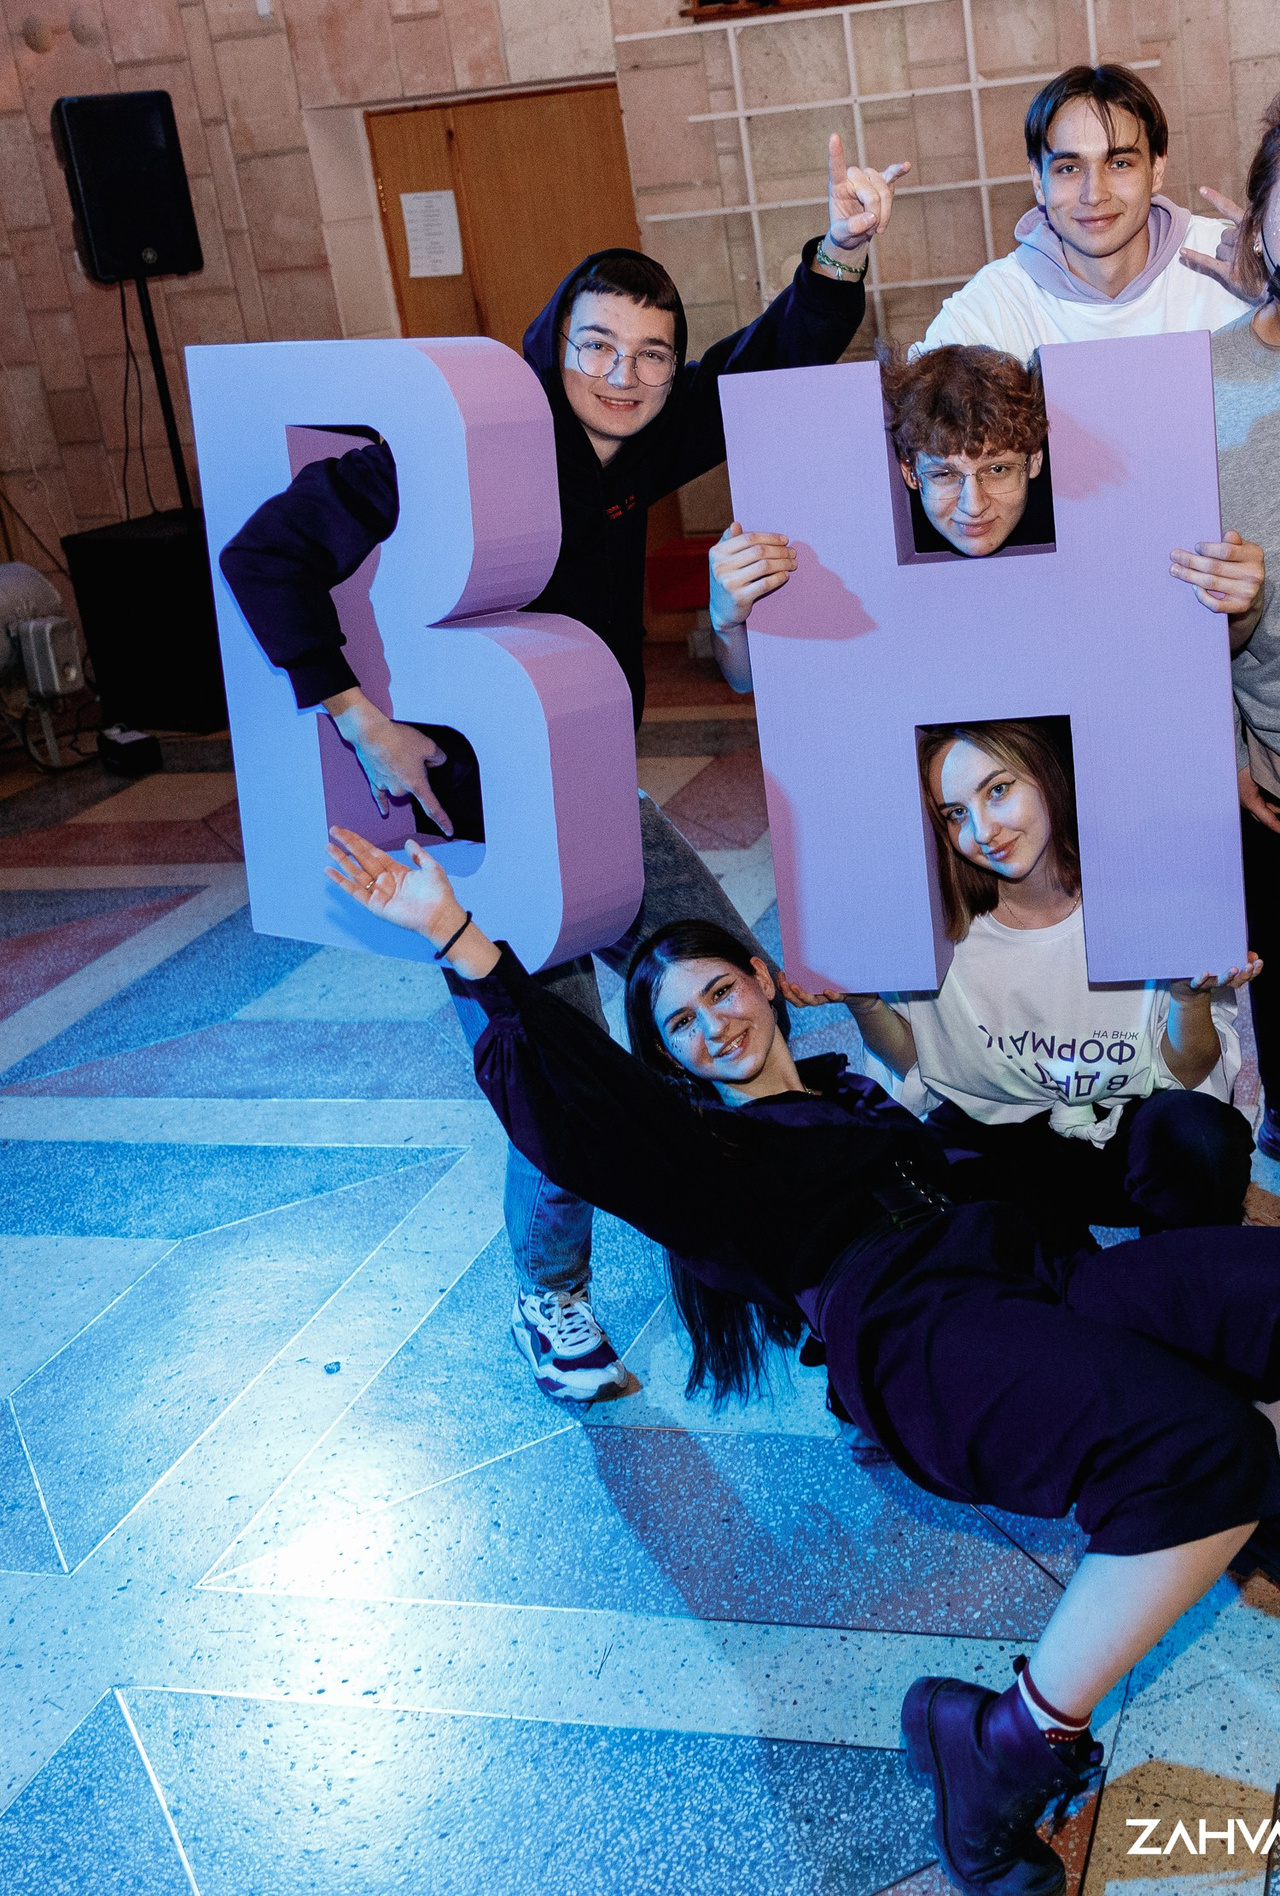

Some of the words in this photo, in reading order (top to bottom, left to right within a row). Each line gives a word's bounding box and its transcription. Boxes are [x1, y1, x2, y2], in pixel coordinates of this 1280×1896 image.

[1092, 1029, 1108, 1039] НА
[1112, 1030, 1139, 1041] ВНЖ
[1106, 1074, 1129, 1091] В
